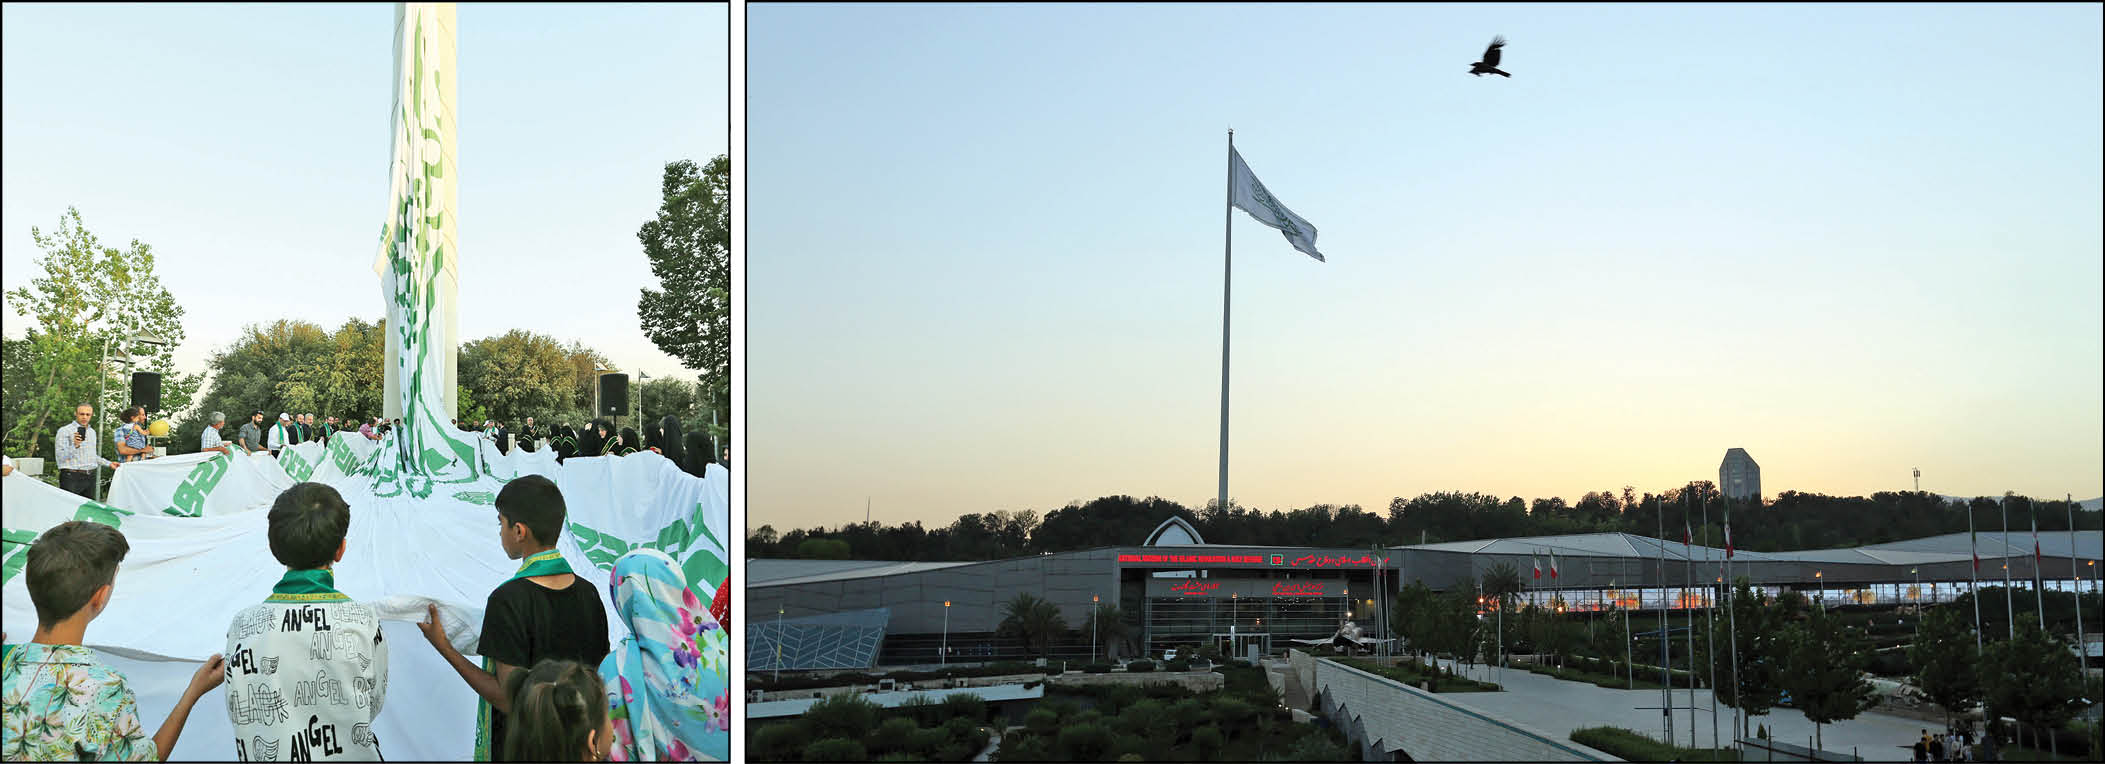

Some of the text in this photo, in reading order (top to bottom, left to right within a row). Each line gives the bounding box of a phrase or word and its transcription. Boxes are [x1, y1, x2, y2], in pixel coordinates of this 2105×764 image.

[281, 605, 331, 632] ANGEL
[294, 670, 349, 707] ANGEL
[291, 715, 343, 762] ANGEL
